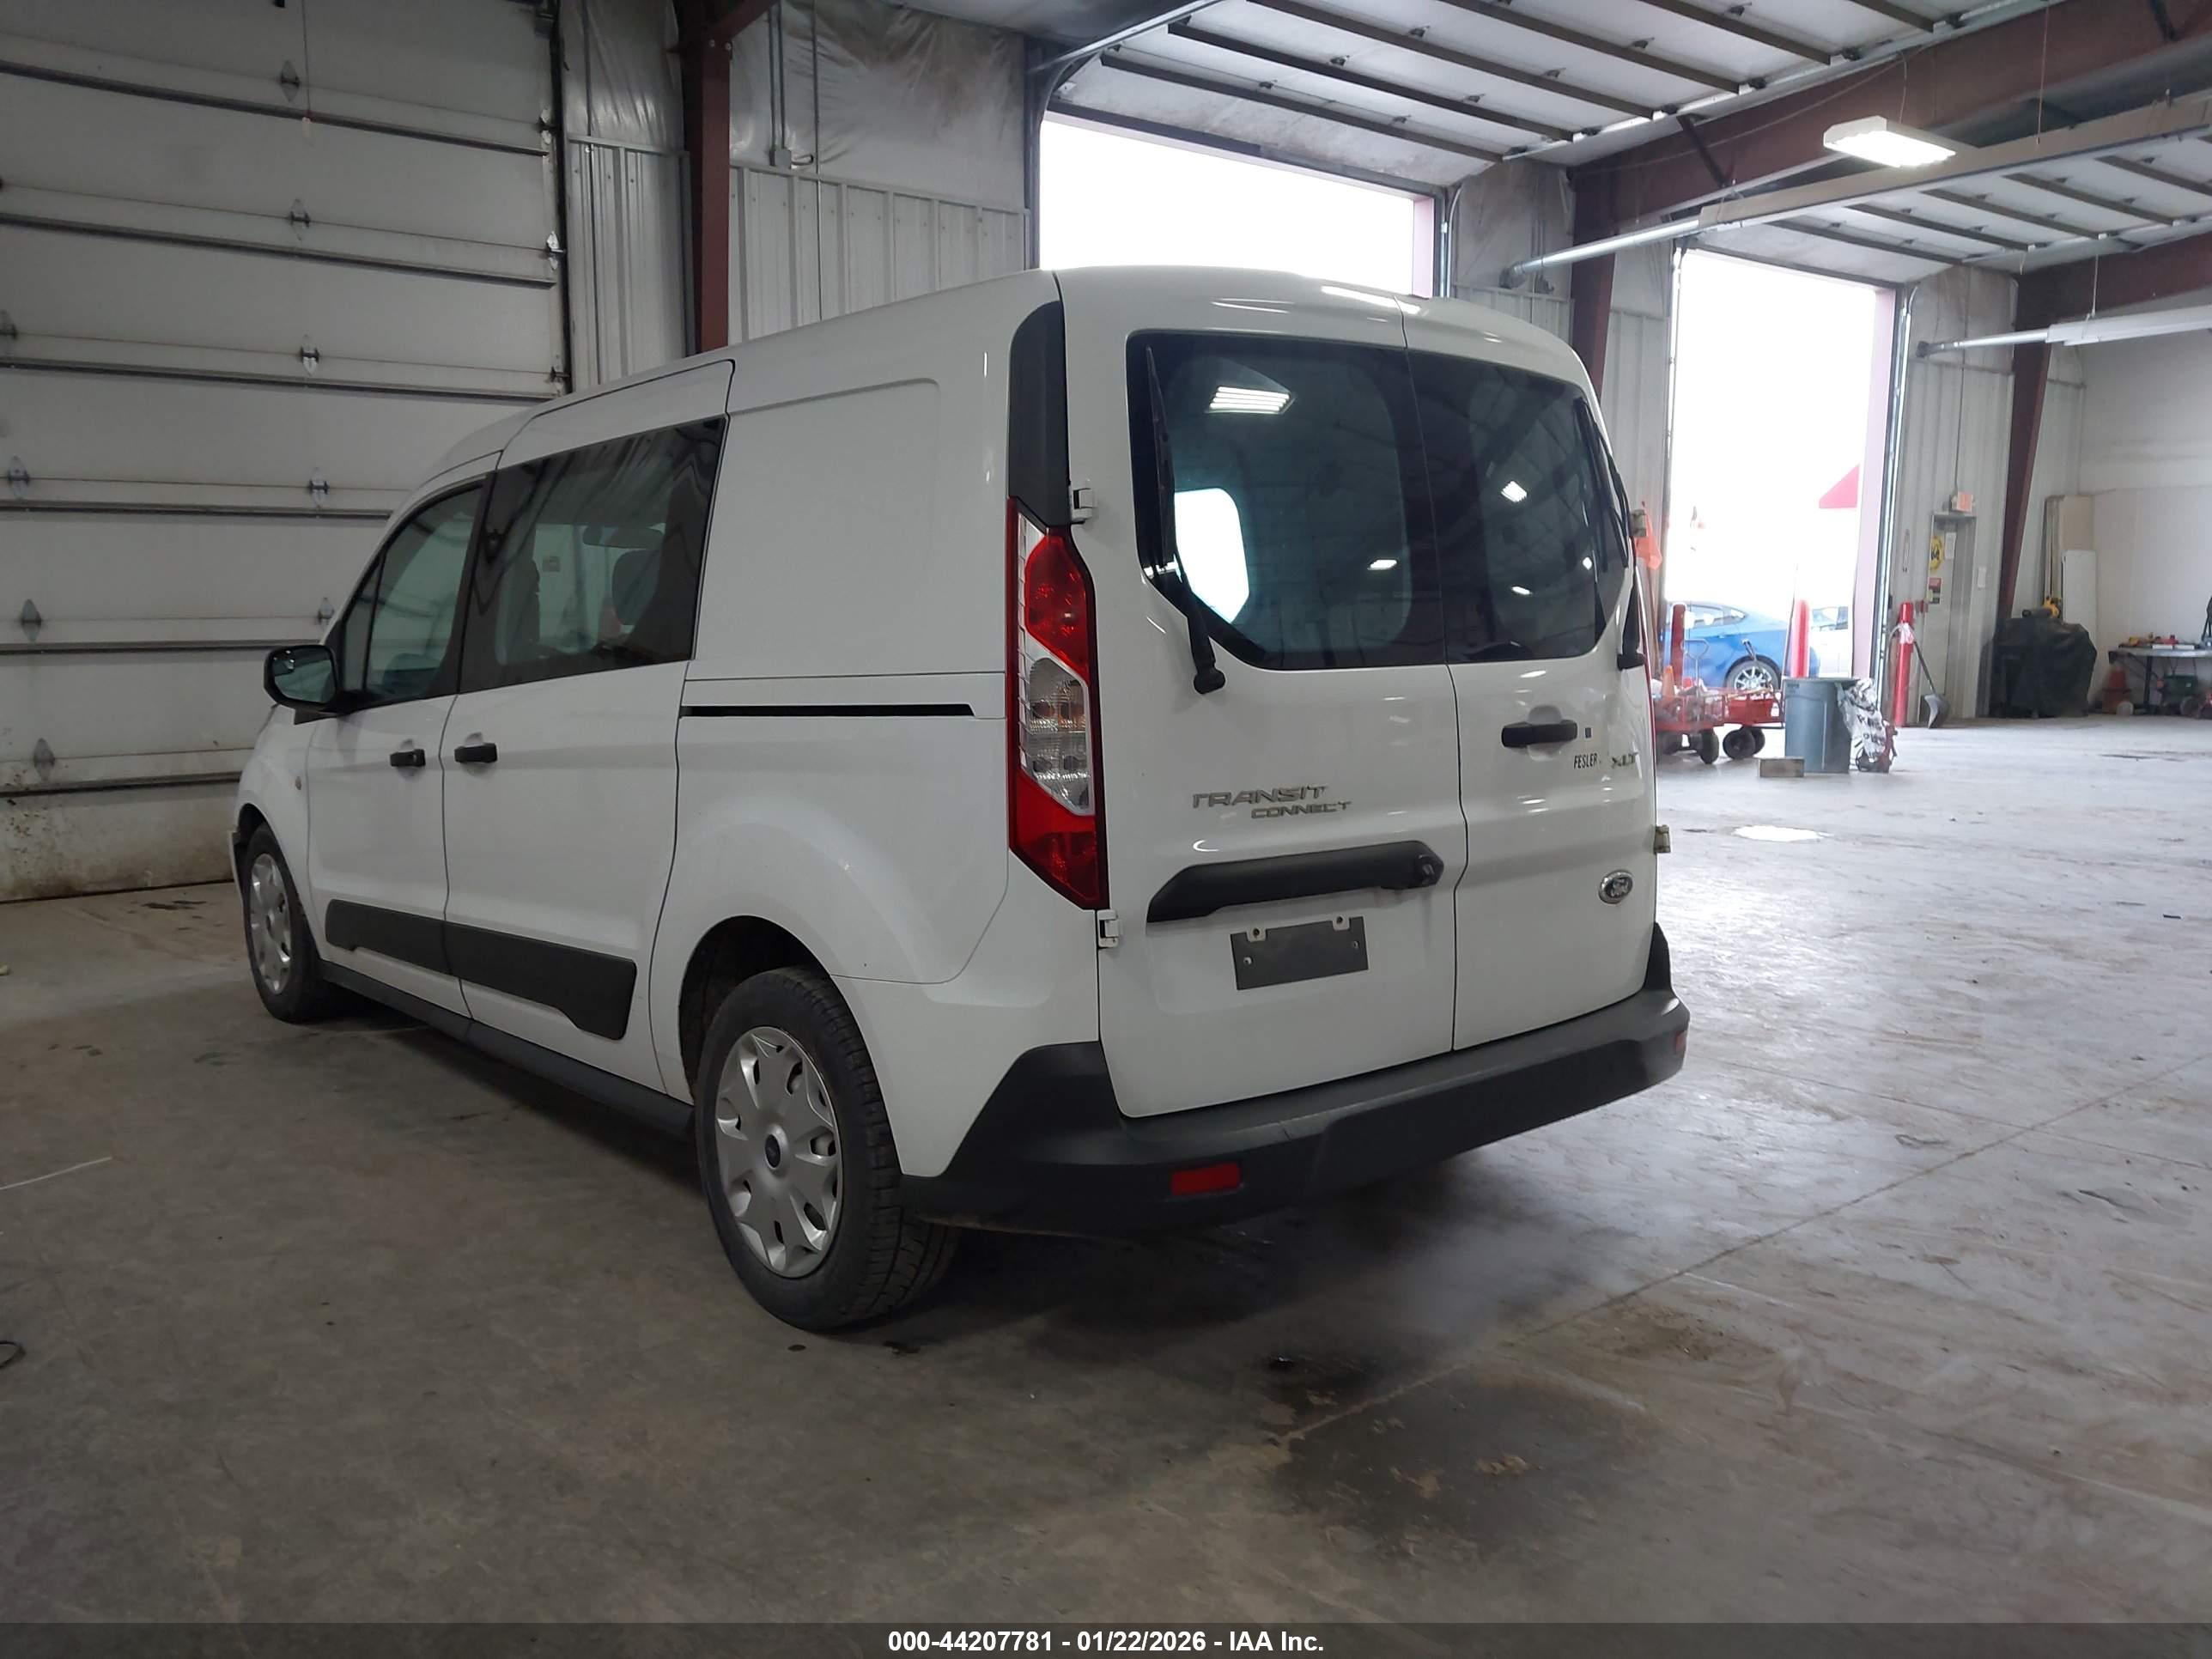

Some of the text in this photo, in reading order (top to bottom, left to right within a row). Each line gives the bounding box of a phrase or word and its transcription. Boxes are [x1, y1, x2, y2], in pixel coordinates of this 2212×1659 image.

[1611, 751, 1639, 769] XLT
[1193, 784, 1328, 809] TRANSIT
[1251, 800, 1352, 819] CONNECT
